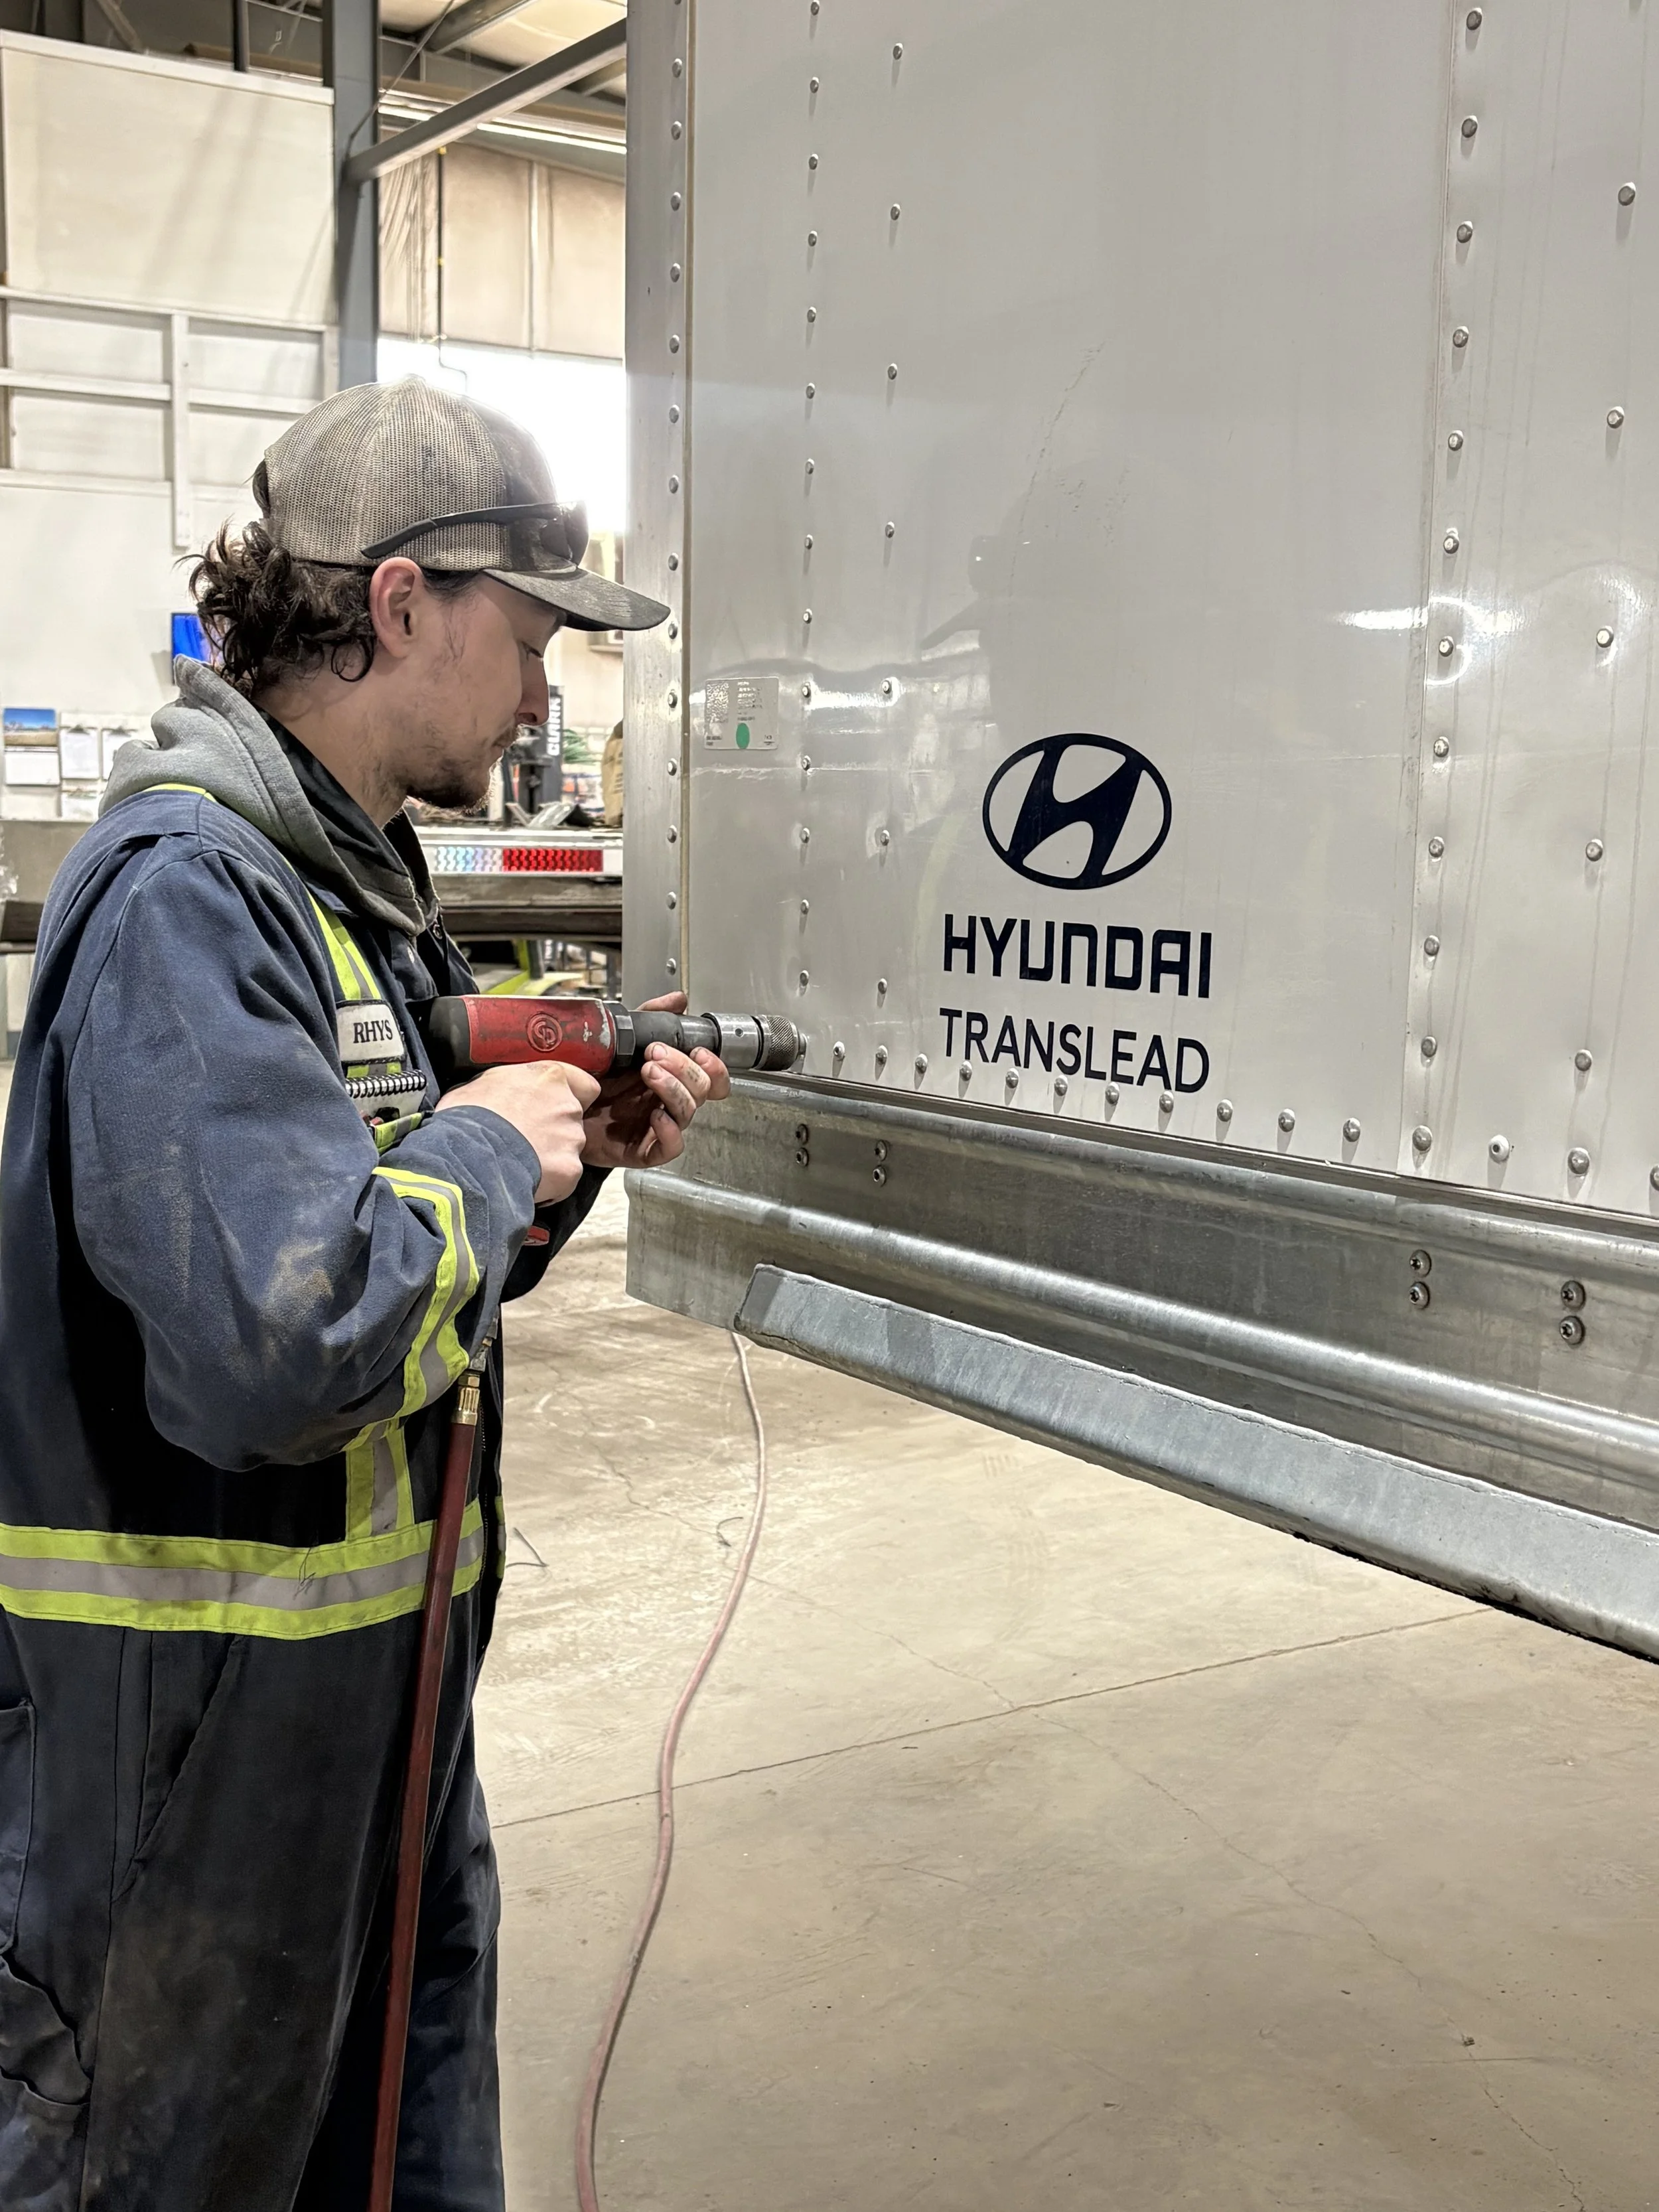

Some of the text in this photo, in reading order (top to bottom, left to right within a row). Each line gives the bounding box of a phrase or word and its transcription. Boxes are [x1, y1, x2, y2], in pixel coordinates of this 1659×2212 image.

[546, 697, 561, 756] CLARK
[944, 913, 1212, 998] HYUNDAI
[353, 1019, 393, 1043] RHYS
[939, 1007, 1210, 1093] TRANSLEAD
